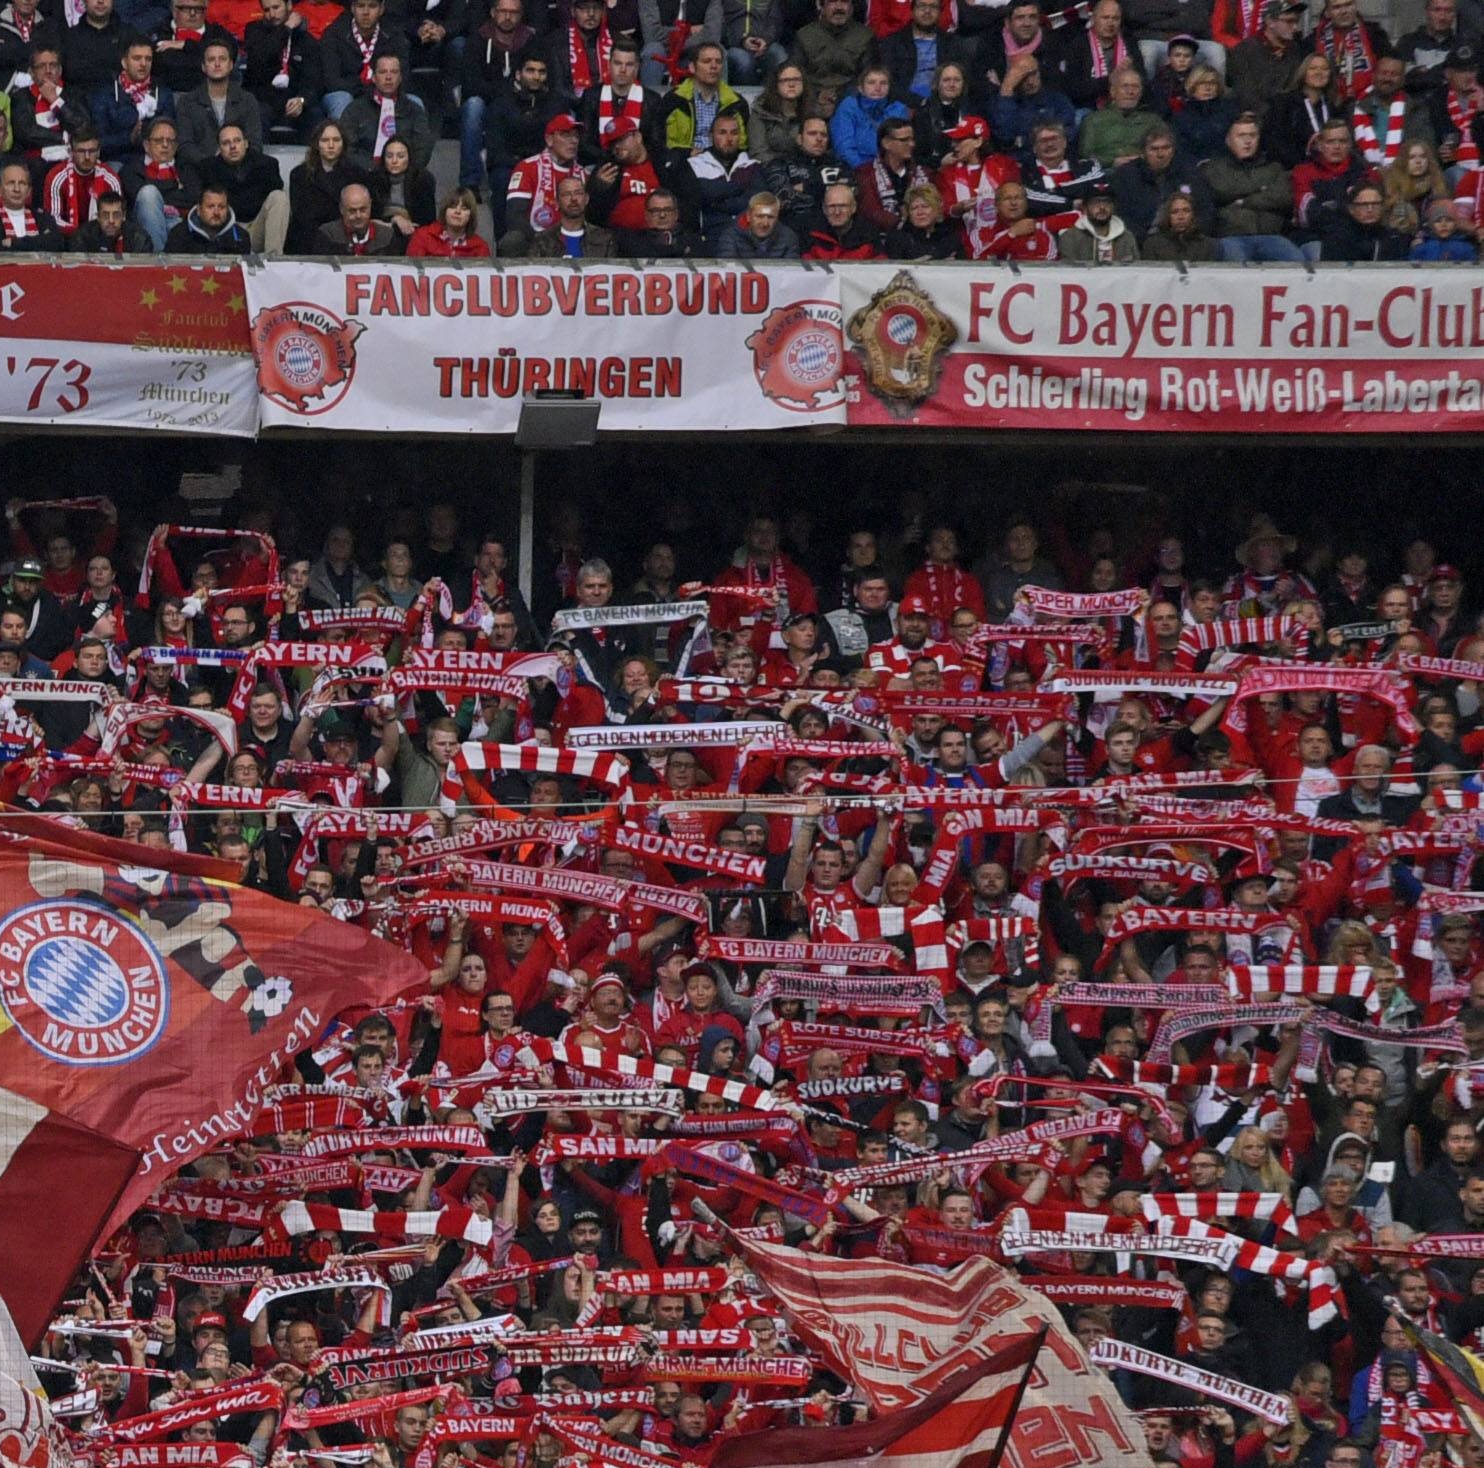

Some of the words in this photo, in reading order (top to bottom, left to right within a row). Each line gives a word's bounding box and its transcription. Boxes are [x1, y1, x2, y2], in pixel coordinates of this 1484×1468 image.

[345, 271, 770, 318] FANCLUBVERBUND
[132, 331, 253, 357] Südkurve
[967, 282, 1036, 345] FC
[1058, 283, 1234, 358] Bayern
[7, 354, 91, 412] '73
[137, 383, 231, 406] München
[434, 347, 684, 400] THÜRINGEN
[963, 363, 1148, 420] Schierling
[584, 605, 646, 620] BAYERN
[616, 826, 767, 880] MÜNCHEN
[542, 868, 626, 904] MÜNCHEN
[0, 903, 119, 962] BAYERN
[42, 964, 157, 1055] MÜNCHEN
[791, 1022, 837, 1039] ROTE
[662, 1269, 710, 1292] MIA
